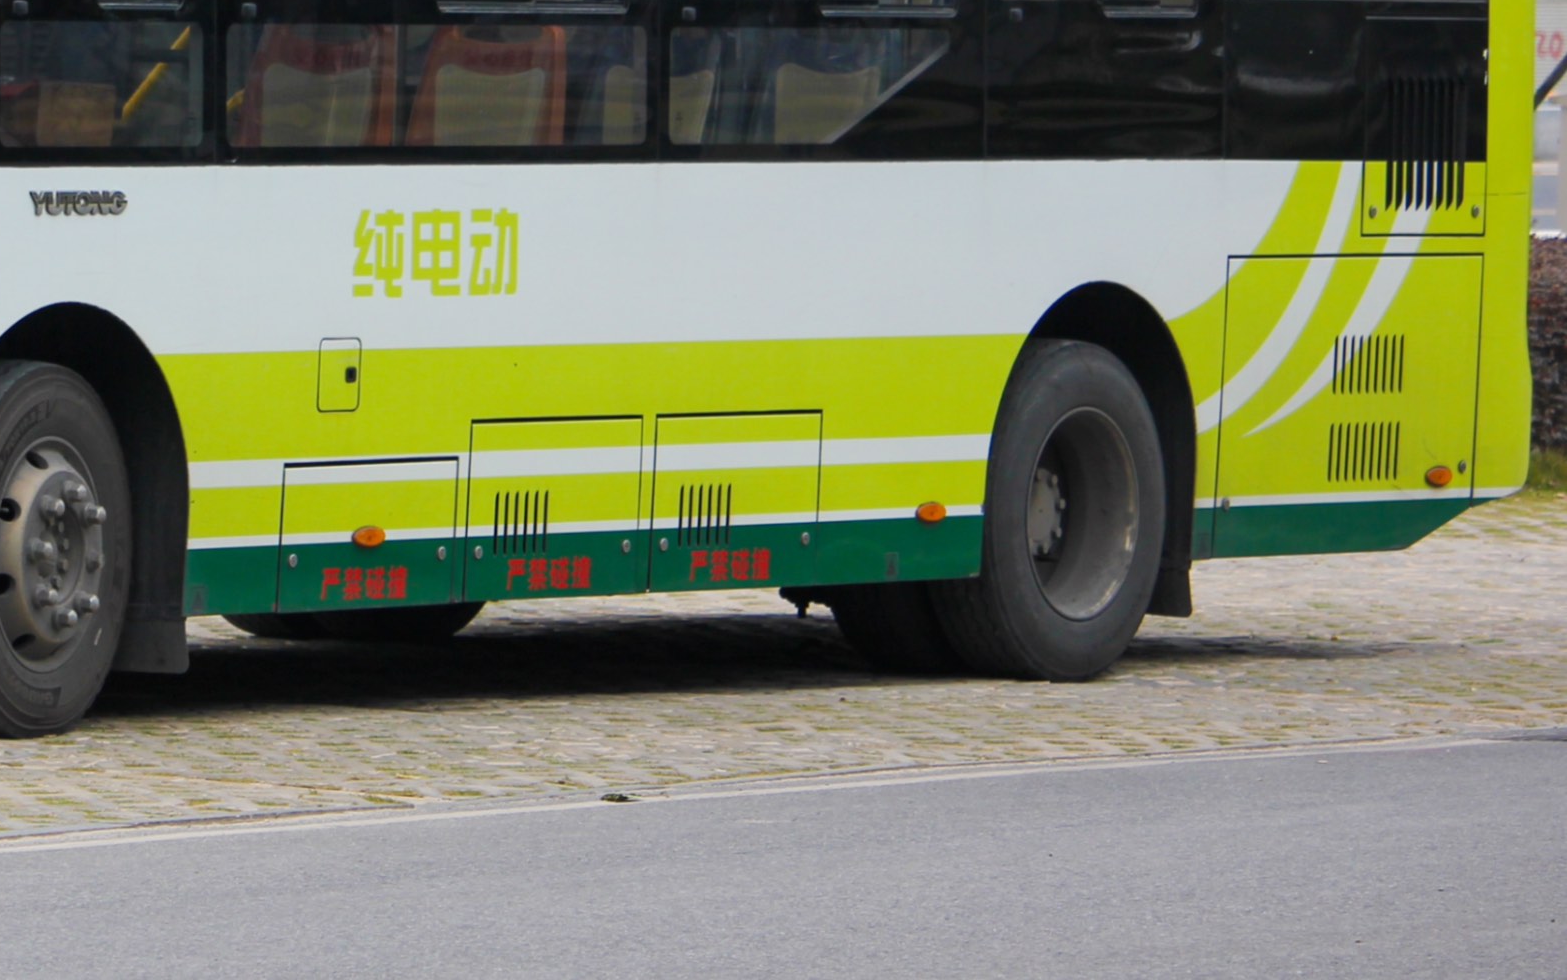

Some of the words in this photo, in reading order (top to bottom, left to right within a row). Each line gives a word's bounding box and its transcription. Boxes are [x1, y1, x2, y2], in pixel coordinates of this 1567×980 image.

[29, 190, 128, 216] YUTONG
[353, 208, 519, 298] 纯电动
[506, 556, 591, 592] 严禁碰撞
[689, 547, 772, 582] 严禁碰撞
[320, 566, 408, 601] 严禁碰撞
